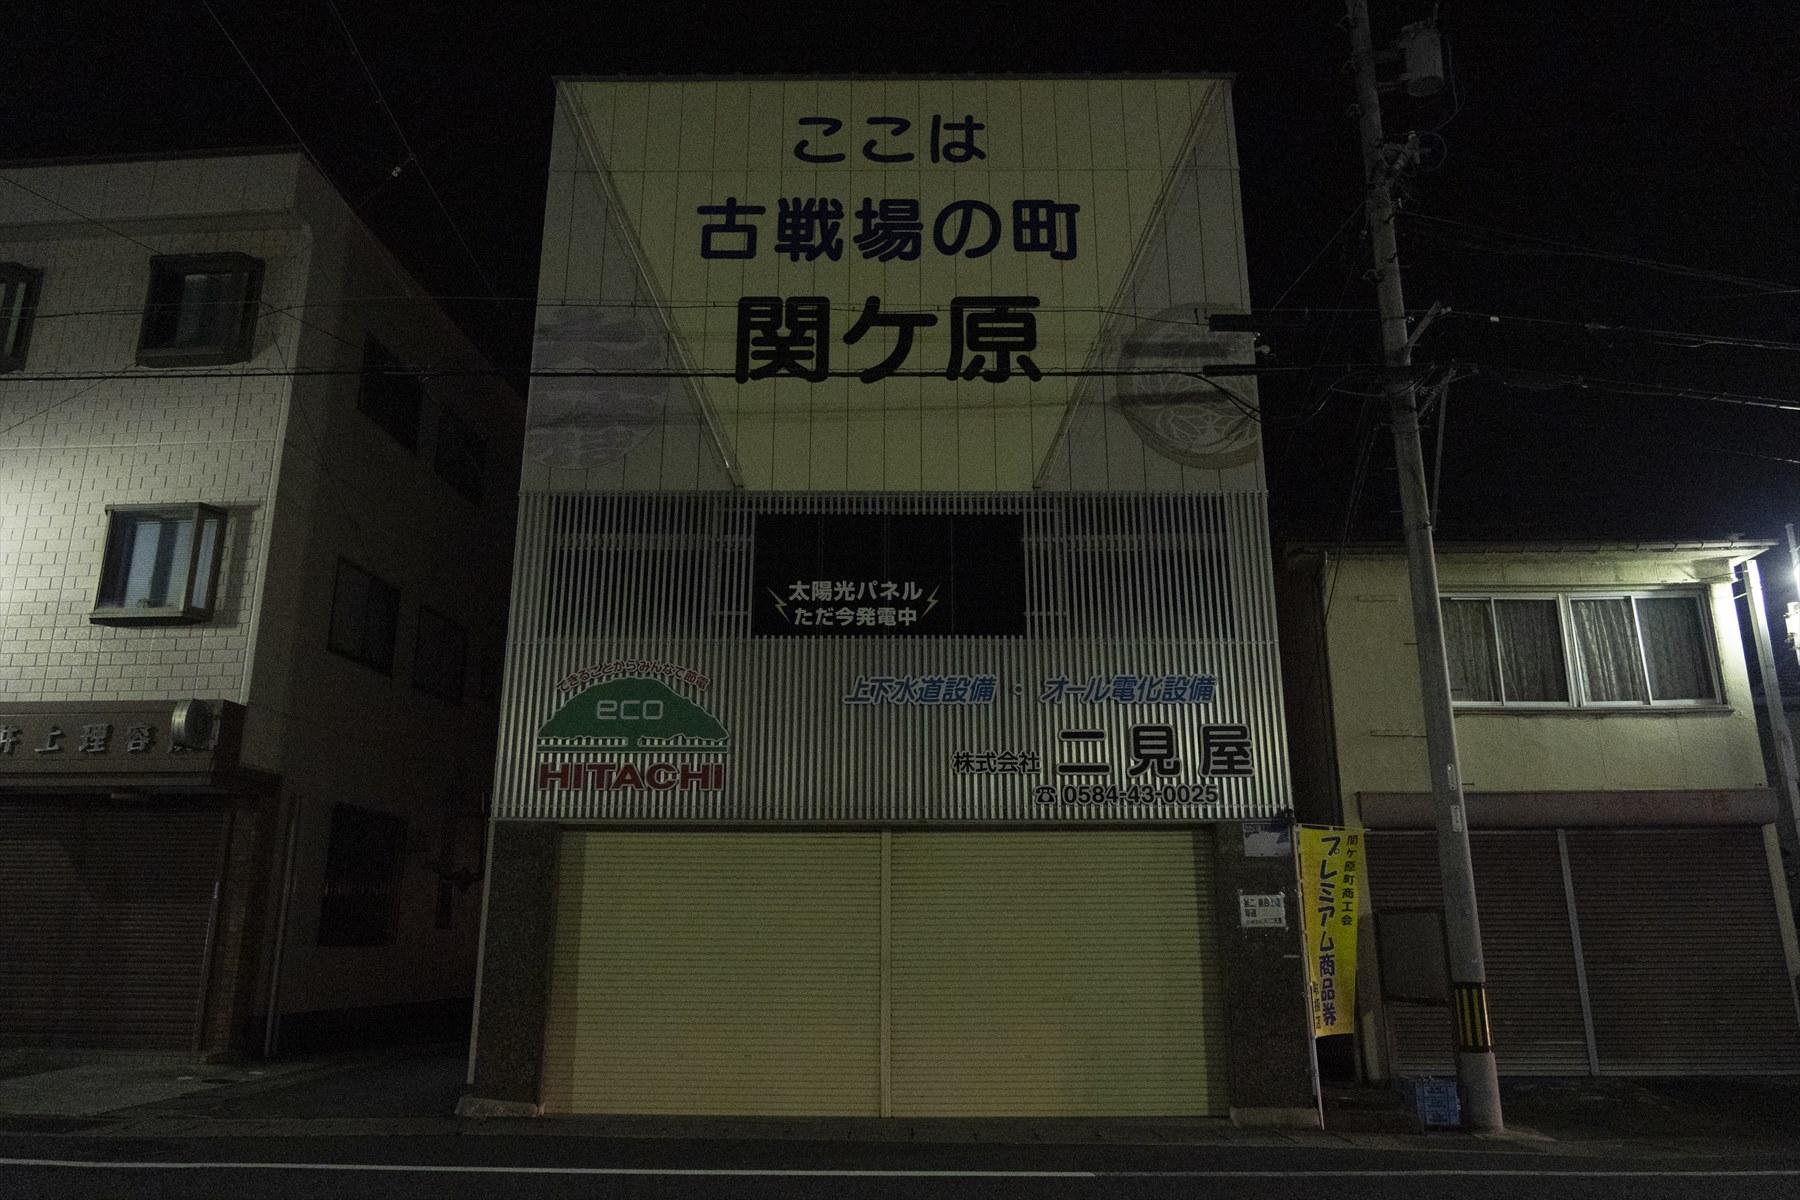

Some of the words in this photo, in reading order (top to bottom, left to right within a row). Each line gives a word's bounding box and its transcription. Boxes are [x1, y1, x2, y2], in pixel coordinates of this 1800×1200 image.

[794, 114, 986, 163] ここは
[697, 197, 1081, 262] 古戦場の町
[735, 296, 1043, 384] 関ケ原
[787, 579, 924, 602] 太陽光パネル
[793, 606, 918, 627] ただ今発電中
[844, 674, 997, 706] 上下水道設備
[1039, 673, 1219, 706] オール電化設備
[596, 699, 664, 721] eco
[0, 722, 196, 756] 井上理容
[1057, 722, 1256, 779] 二見屋
[538, 761, 725, 792] HITACHI
[951, 749, 1040, 775] 株式会社
[1061, 783, 1219, 805] 0584-43-0025
[1317, 835, 1342, 1027] プレミアム商品券
